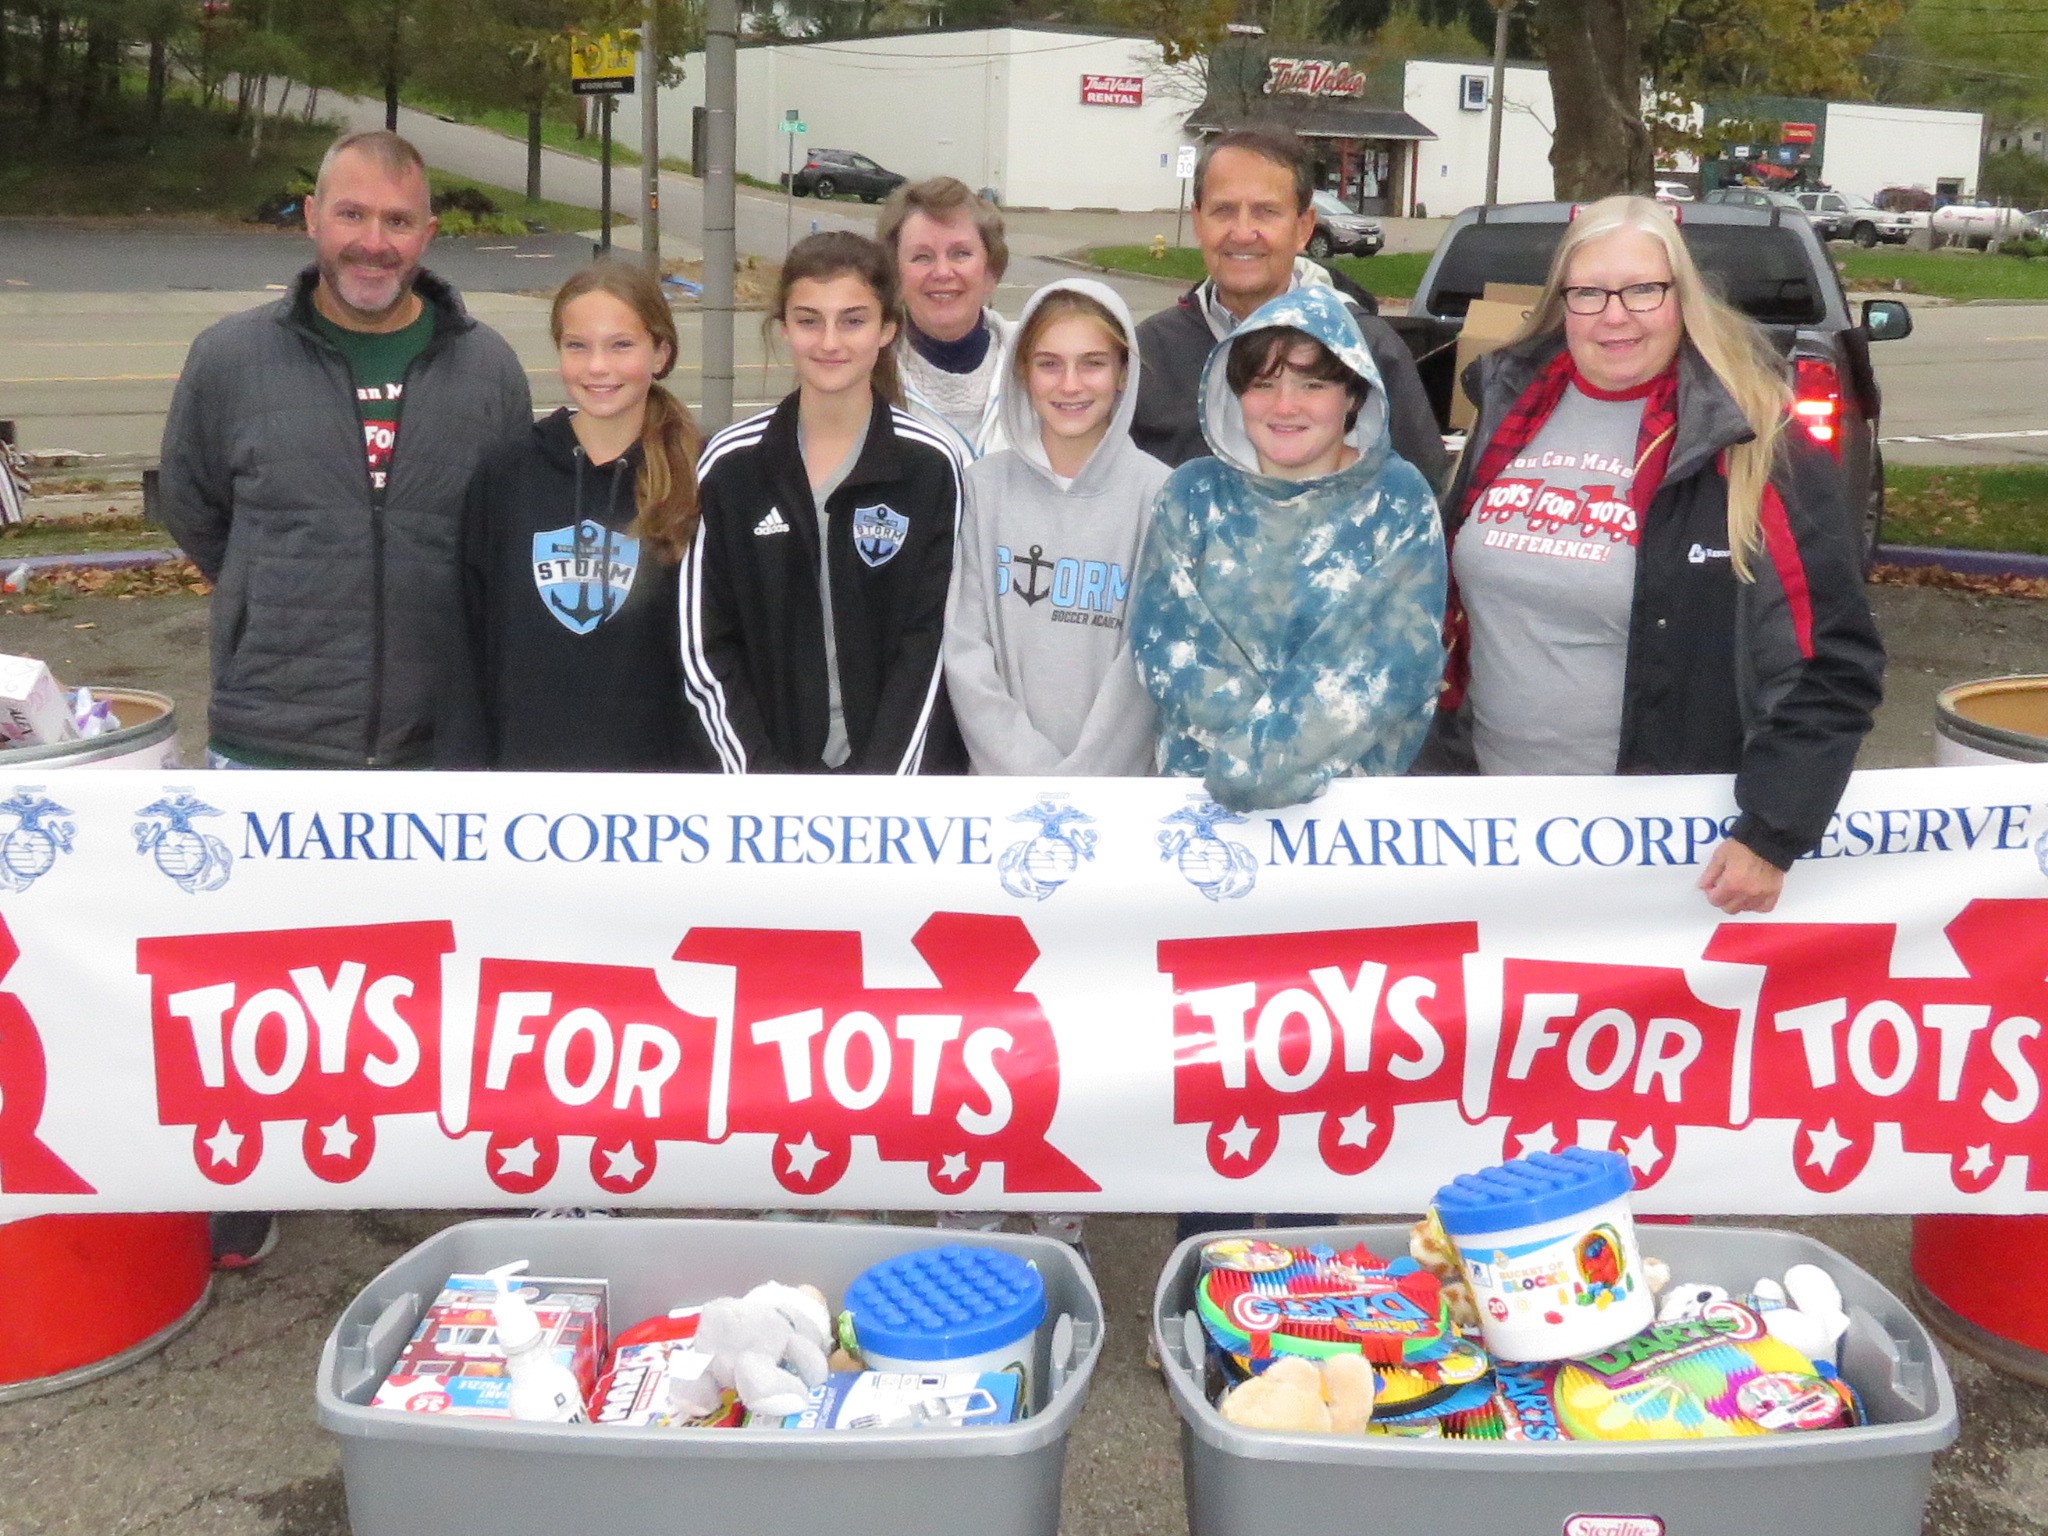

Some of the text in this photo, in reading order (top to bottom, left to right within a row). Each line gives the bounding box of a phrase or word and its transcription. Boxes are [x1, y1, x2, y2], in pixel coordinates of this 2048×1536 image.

[1084, 76, 1141, 92] True Value
[1087, 92, 1136, 104] RENTAL
[1179, 162, 1192, 174] 30
[357, 388, 382, 400] an
[1505, 451, 1634, 478] ou Can Make
[1487, 484, 1638, 532] TOYS FOR TOTS
[856, 525, 904, 542] STORM
[1484, 529, 1611, 563] DIFFERENCE!
[537, 558, 632, 585] STORM
[1051, 609, 1089, 624] SOCCER
[241, 811, 992, 864] MARINE CORPS RESERVE
[1265, 817, 1520, 867] MARINE
[1794, 804, 2032, 861] ESERVE
[168, 960, 1014, 1136] TOYS FOR TOTS
[1191, 960, 2042, 1124] TOYS FOR TOTS
[1488, 1301, 1506, 1315] 20
[413, 1397, 445, 1412] 36
